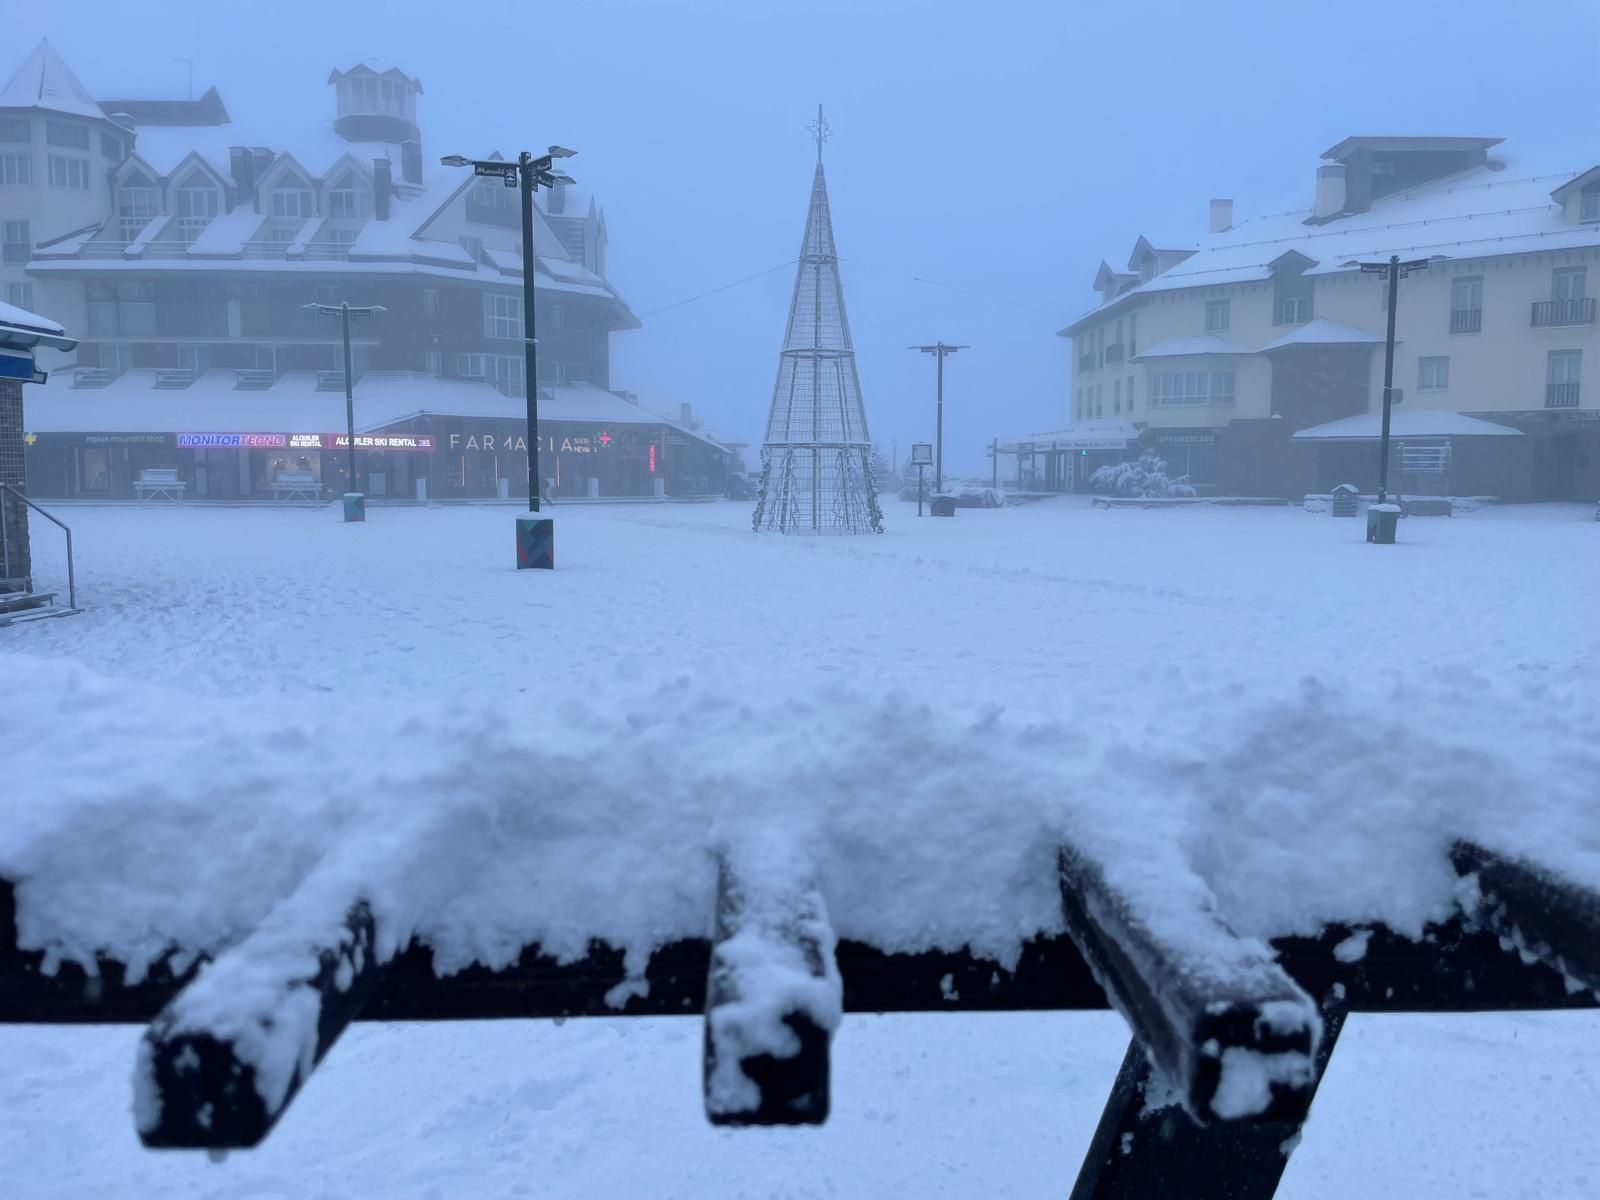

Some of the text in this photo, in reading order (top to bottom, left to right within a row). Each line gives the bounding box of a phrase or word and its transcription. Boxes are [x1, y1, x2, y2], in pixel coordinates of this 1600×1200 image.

[110, 435, 144, 443] mountain
[146, 435, 165, 444] shop
[374, 438, 388, 447] SKI
[389, 438, 416, 447] RENTAL
